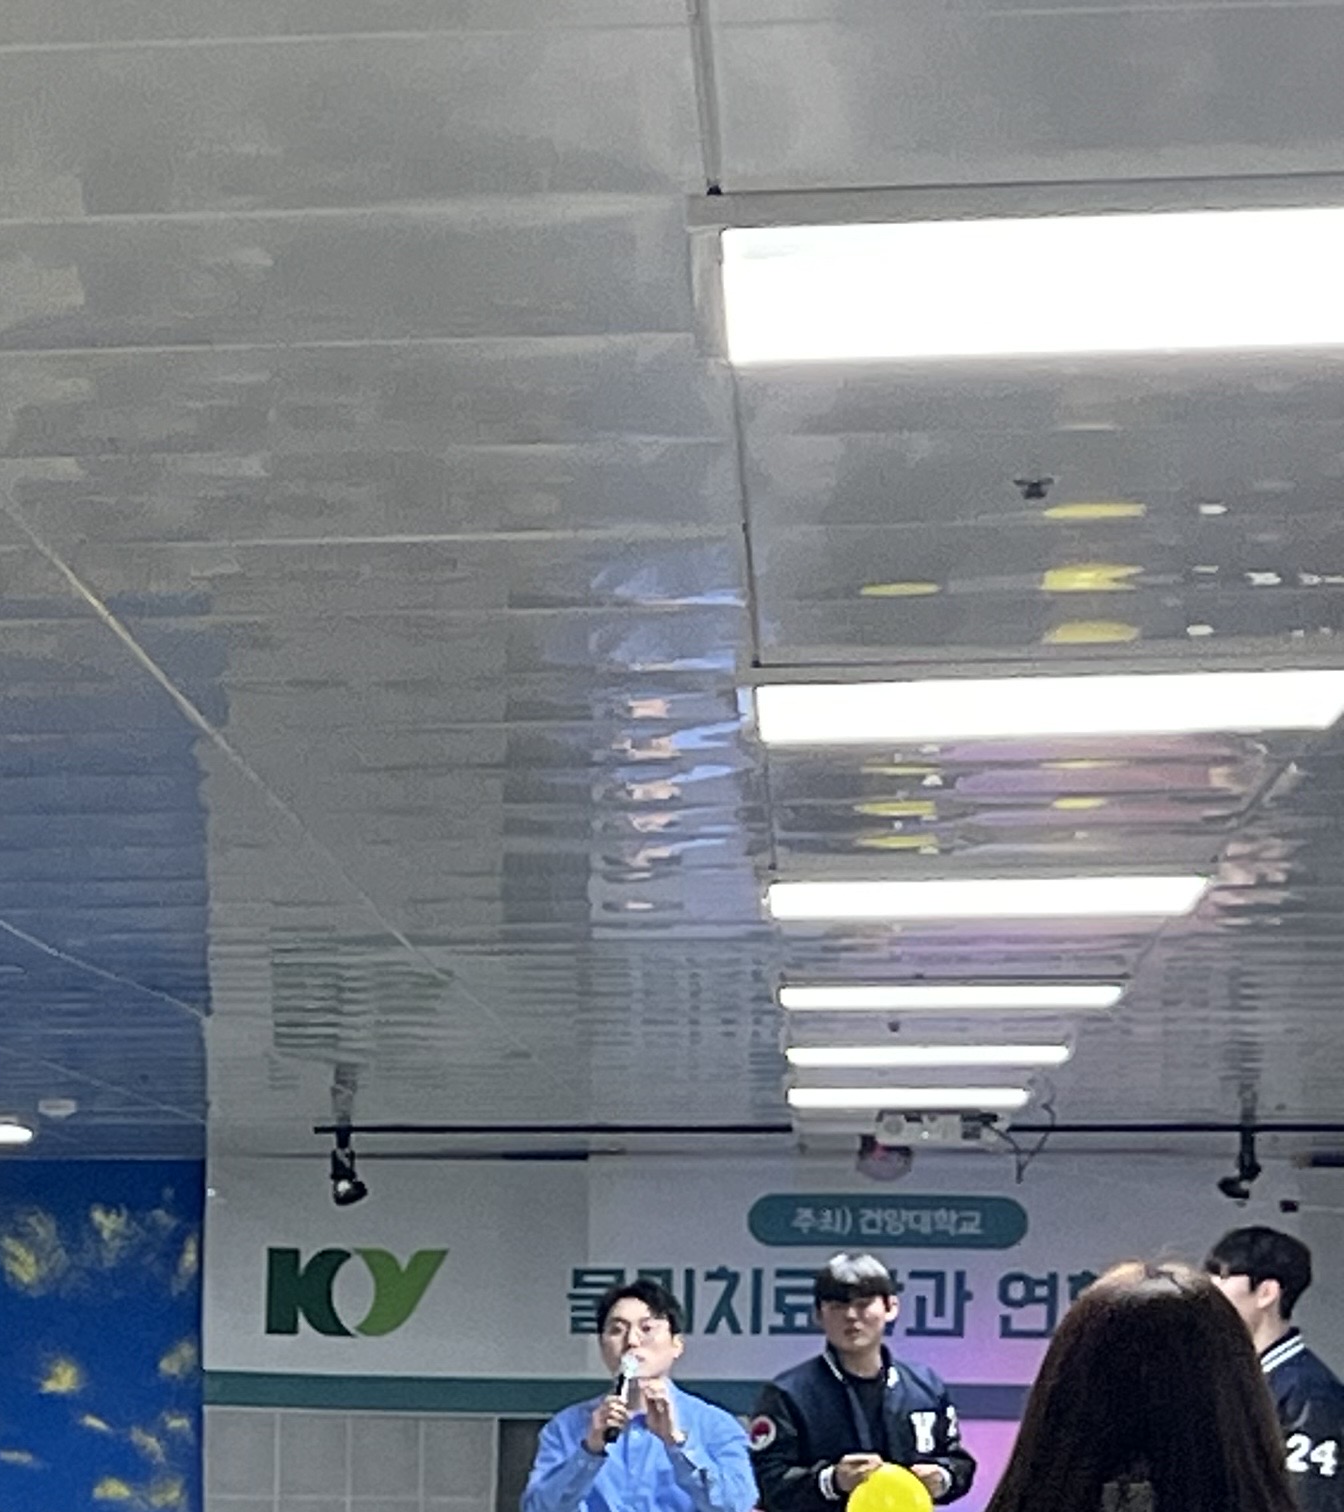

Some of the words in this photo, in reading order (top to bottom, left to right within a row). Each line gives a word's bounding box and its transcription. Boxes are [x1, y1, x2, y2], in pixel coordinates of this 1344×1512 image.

[265, 1246, 450, 1338] KY
[998, 1270, 1099, 1339] 연
[1285, 1432, 1338, 1477] 24
